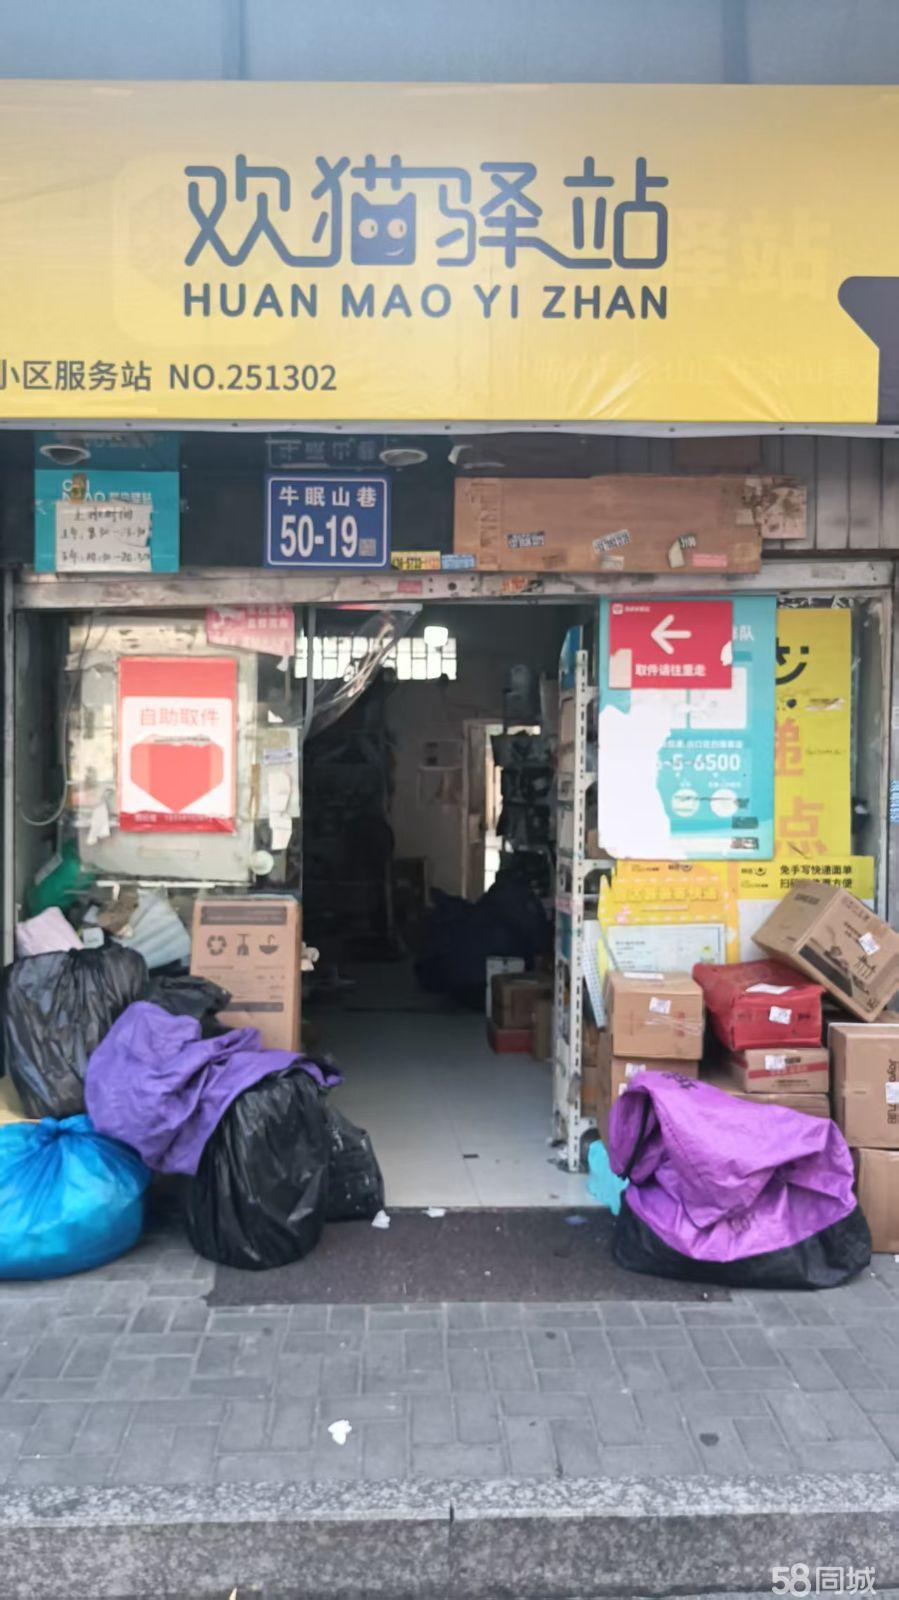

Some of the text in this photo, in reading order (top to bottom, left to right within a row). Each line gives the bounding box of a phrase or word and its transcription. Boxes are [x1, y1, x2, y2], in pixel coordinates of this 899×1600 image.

[184, 153, 669, 270] 欢猫驿站
[184, 283, 668, 320] HUAN MAO YI ZHAN
[0, 359, 337, 392] 小区服务站 NO.251302
[278, 485, 377, 508] 牛眠山巷
[280, 514, 358, 558] 50-19
[140, 707, 220, 726] 自助取件
